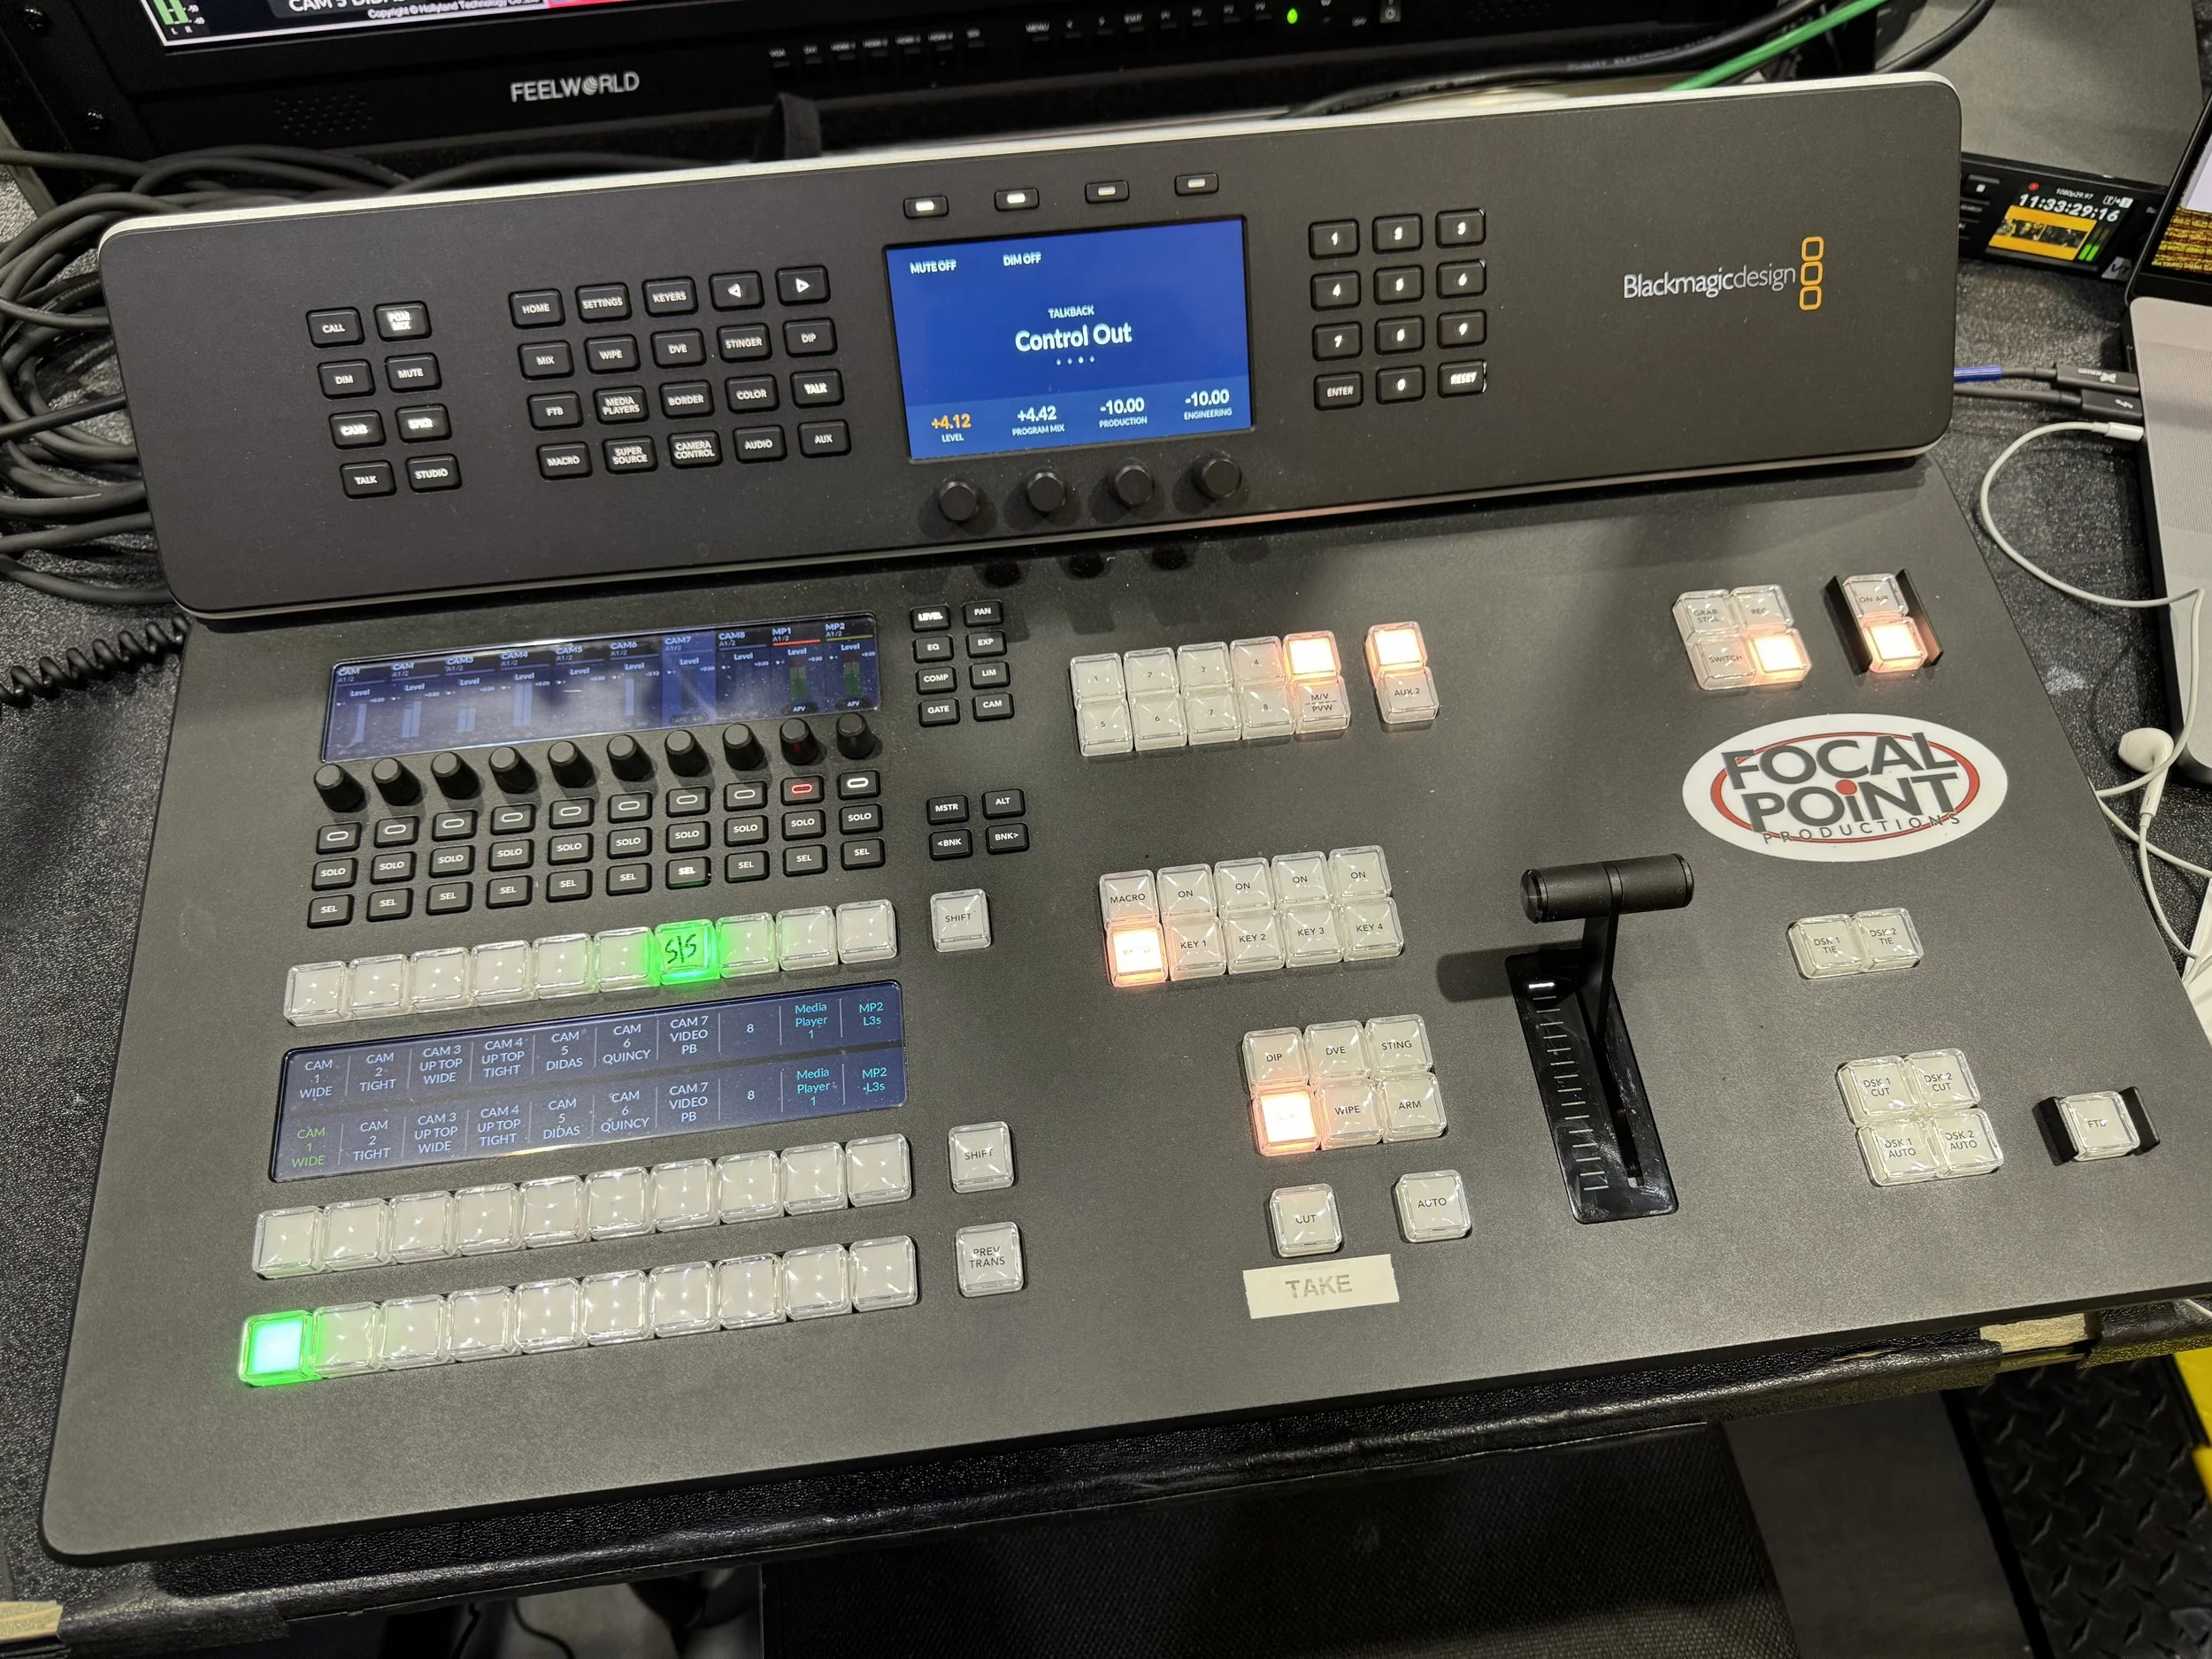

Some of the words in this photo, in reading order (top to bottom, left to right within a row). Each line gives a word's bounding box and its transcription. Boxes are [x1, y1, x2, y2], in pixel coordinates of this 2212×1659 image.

[510, 71, 640, 103] FEELWORLD
[1002, 254, 1023, 267] DIM
[1023, 251, 1042, 265] OFF
[910, 261, 937, 274] MUTE
[938, 258, 957, 273] OFF
[652, 291, 687, 303] KEYERS
[522, 303, 549, 314] HOME
[581, 297, 623, 310] SETTINGS
[1048, 304, 1095, 319] TALKBACK
[322, 324, 345, 334] CALL
[801, 333, 817, 343] DIP
[1015, 325, 1090, 352] Control
[1092, 321, 1133, 345] Out
[725, 336, 763, 349] STINGER
[668, 343, 687, 354] DVE
[598, 349, 624, 360] WIPE
[536, 356, 555, 365] MIX
[397, 368, 424, 379] MUTE
[334, 375, 353, 385] DIM
[736, 388, 767, 400] COLOR
[803, 382, 828, 395] TALK
[1327, 386, 1354, 397] ENTER
[604, 396, 635, 406] MEDIA
[668, 395, 704, 406] BORDER
[1184, 388, 1230, 406] -10.00
[603, 404, 640, 416] PLAYERS
[1100, 397, 1145, 414] -10.00
[546, 406, 564, 417] FTB
[1017, 405, 1057, 422] +4.42
[1184, 407, 1233, 421] ENGINEERING
[931, 413, 972, 430] +4.12
[1099, 416, 1148, 429] PRODUCTION
[1011, 425, 1049, 437] PROGRAM
[1049, 423, 1065, 434] MIX
[814, 434, 833, 444] AUX
[941, 433, 964, 443] LEVEL
[674, 440, 712, 451] CAMERA
[744, 438, 773, 450] AUDIO
[614, 446, 643, 456] SUPER
[674, 449, 715, 459] CONTROL
[546, 456, 580, 467] MACRO
[612, 454, 648, 465] SOURCE
[354, 474, 378, 485] TALK
[415, 468, 449, 480] STUDIO
[974, 607, 992, 616] PAN
[772, 627, 792, 636] MP1
[825, 622, 846, 631] MP2
[610, 641, 637, 650] CAM6
[664, 636, 692, 645] CAM7
[923, 673, 949, 682] COMP
[927, 705, 949, 714] GATE
[1312, 703, 1333, 712] PVW
[1721, 732, 1960, 790] FOCAL
[935, 803, 958, 812] MSTR
[848, 812, 872, 821] SOLO
[791, 818, 815, 827] SOLO
[1763, 812, 1962, 845] PRODUCTIONS
[854, 848, 870, 856] SEL
[1110, 893, 1146, 903] MACRO
[945, 913, 972, 923] SHIFT
[1180, 941, 1200, 949] KEY
[795, 1002, 827, 1015] Media
[859, 1002, 884, 1013] MP2
[670, 1018, 699, 1029] CAM
[702, 1016, 709, 1025] 7
[795, 1016, 828, 1029] Player
[863, 1016, 882, 1025] L3s
[614, 1024, 641, 1036] CAM
[747, 1024, 754, 1033] 8
[809, 1029, 815, 1039] 1
[551, 1031, 580, 1043] CAM
[670, 1029, 709, 1041] VIDEO
[485, 1039, 512, 1051] CAM
[515, 1038, 523, 1047] 4
[624, 1038, 631, 1048] 6
[682, 1043, 697, 1054] PB
[1381, 1040, 1412, 1050] STING
[423, 1046, 451, 1057] CAM
[454, 1045, 461, 1054] 3
[562, 1046, 569, 1055] 5
[1325, 1046, 1346, 1056] DVE
[367, 1052, 395, 1064] CAM
[481, 1054, 498, 1065] UP
[500, 1050, 525, 1063] TOP
[603, 1049, 651, 1064] QUINCY
[1266, 1052, 1283, 1063] DIP
[305, 1059, 333, 1071] CAM
[420, 1061, 437, 1071] UP
[438, 1057, 464, 1070] TOP
[546, 1057, 584, 1071] DIDAS
[375, 1067, 382, 1077] 2
[483, 1064, 521, 1079] TIGHT
[314, 1073, 319, 1084] 1
[424, 1071, 457, 1085] WIDE
[359, 1079, 397, 1092] TIGHT
[1932, 1083, 1951, 1092] CUT
[299, 1086, 334, 1099] WIDE
[1334, 1104, 1361, 1115] WIPE
[1398, 1100, 1422, 1110] ARM
[1950, 1141, 1978, 1150] AUTO
[1888, 1148, 1916, 1158] AUTO
[1417, 1196, 1447, 1209] AUTO
[1295, 1214, 1317, 1225] CUT
[973, 1246, 1000, 1256] PREV
[970, 1256, 1006, 1269] TRANS
[1285, 1274, 1353, 1299] TAKE
